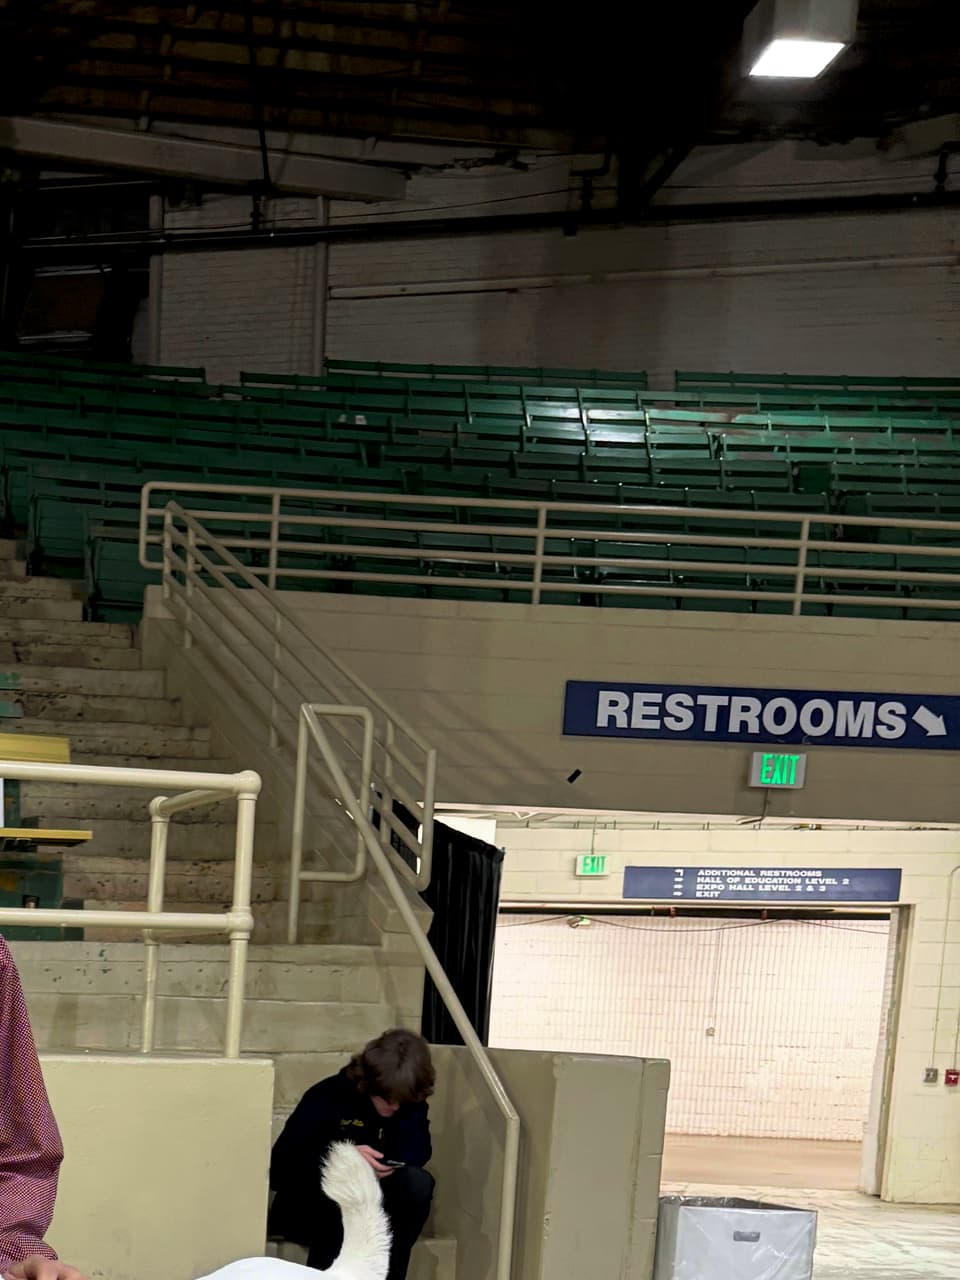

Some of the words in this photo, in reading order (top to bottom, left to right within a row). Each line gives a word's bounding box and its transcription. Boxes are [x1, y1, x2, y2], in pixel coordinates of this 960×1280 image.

[596, 690, 907, 740] RESTROOMS
[760, 753, 800, 785] EXIT
[583, 855, 607, 873] EXIT
[744, 877, 802, 885] EDUCATION
